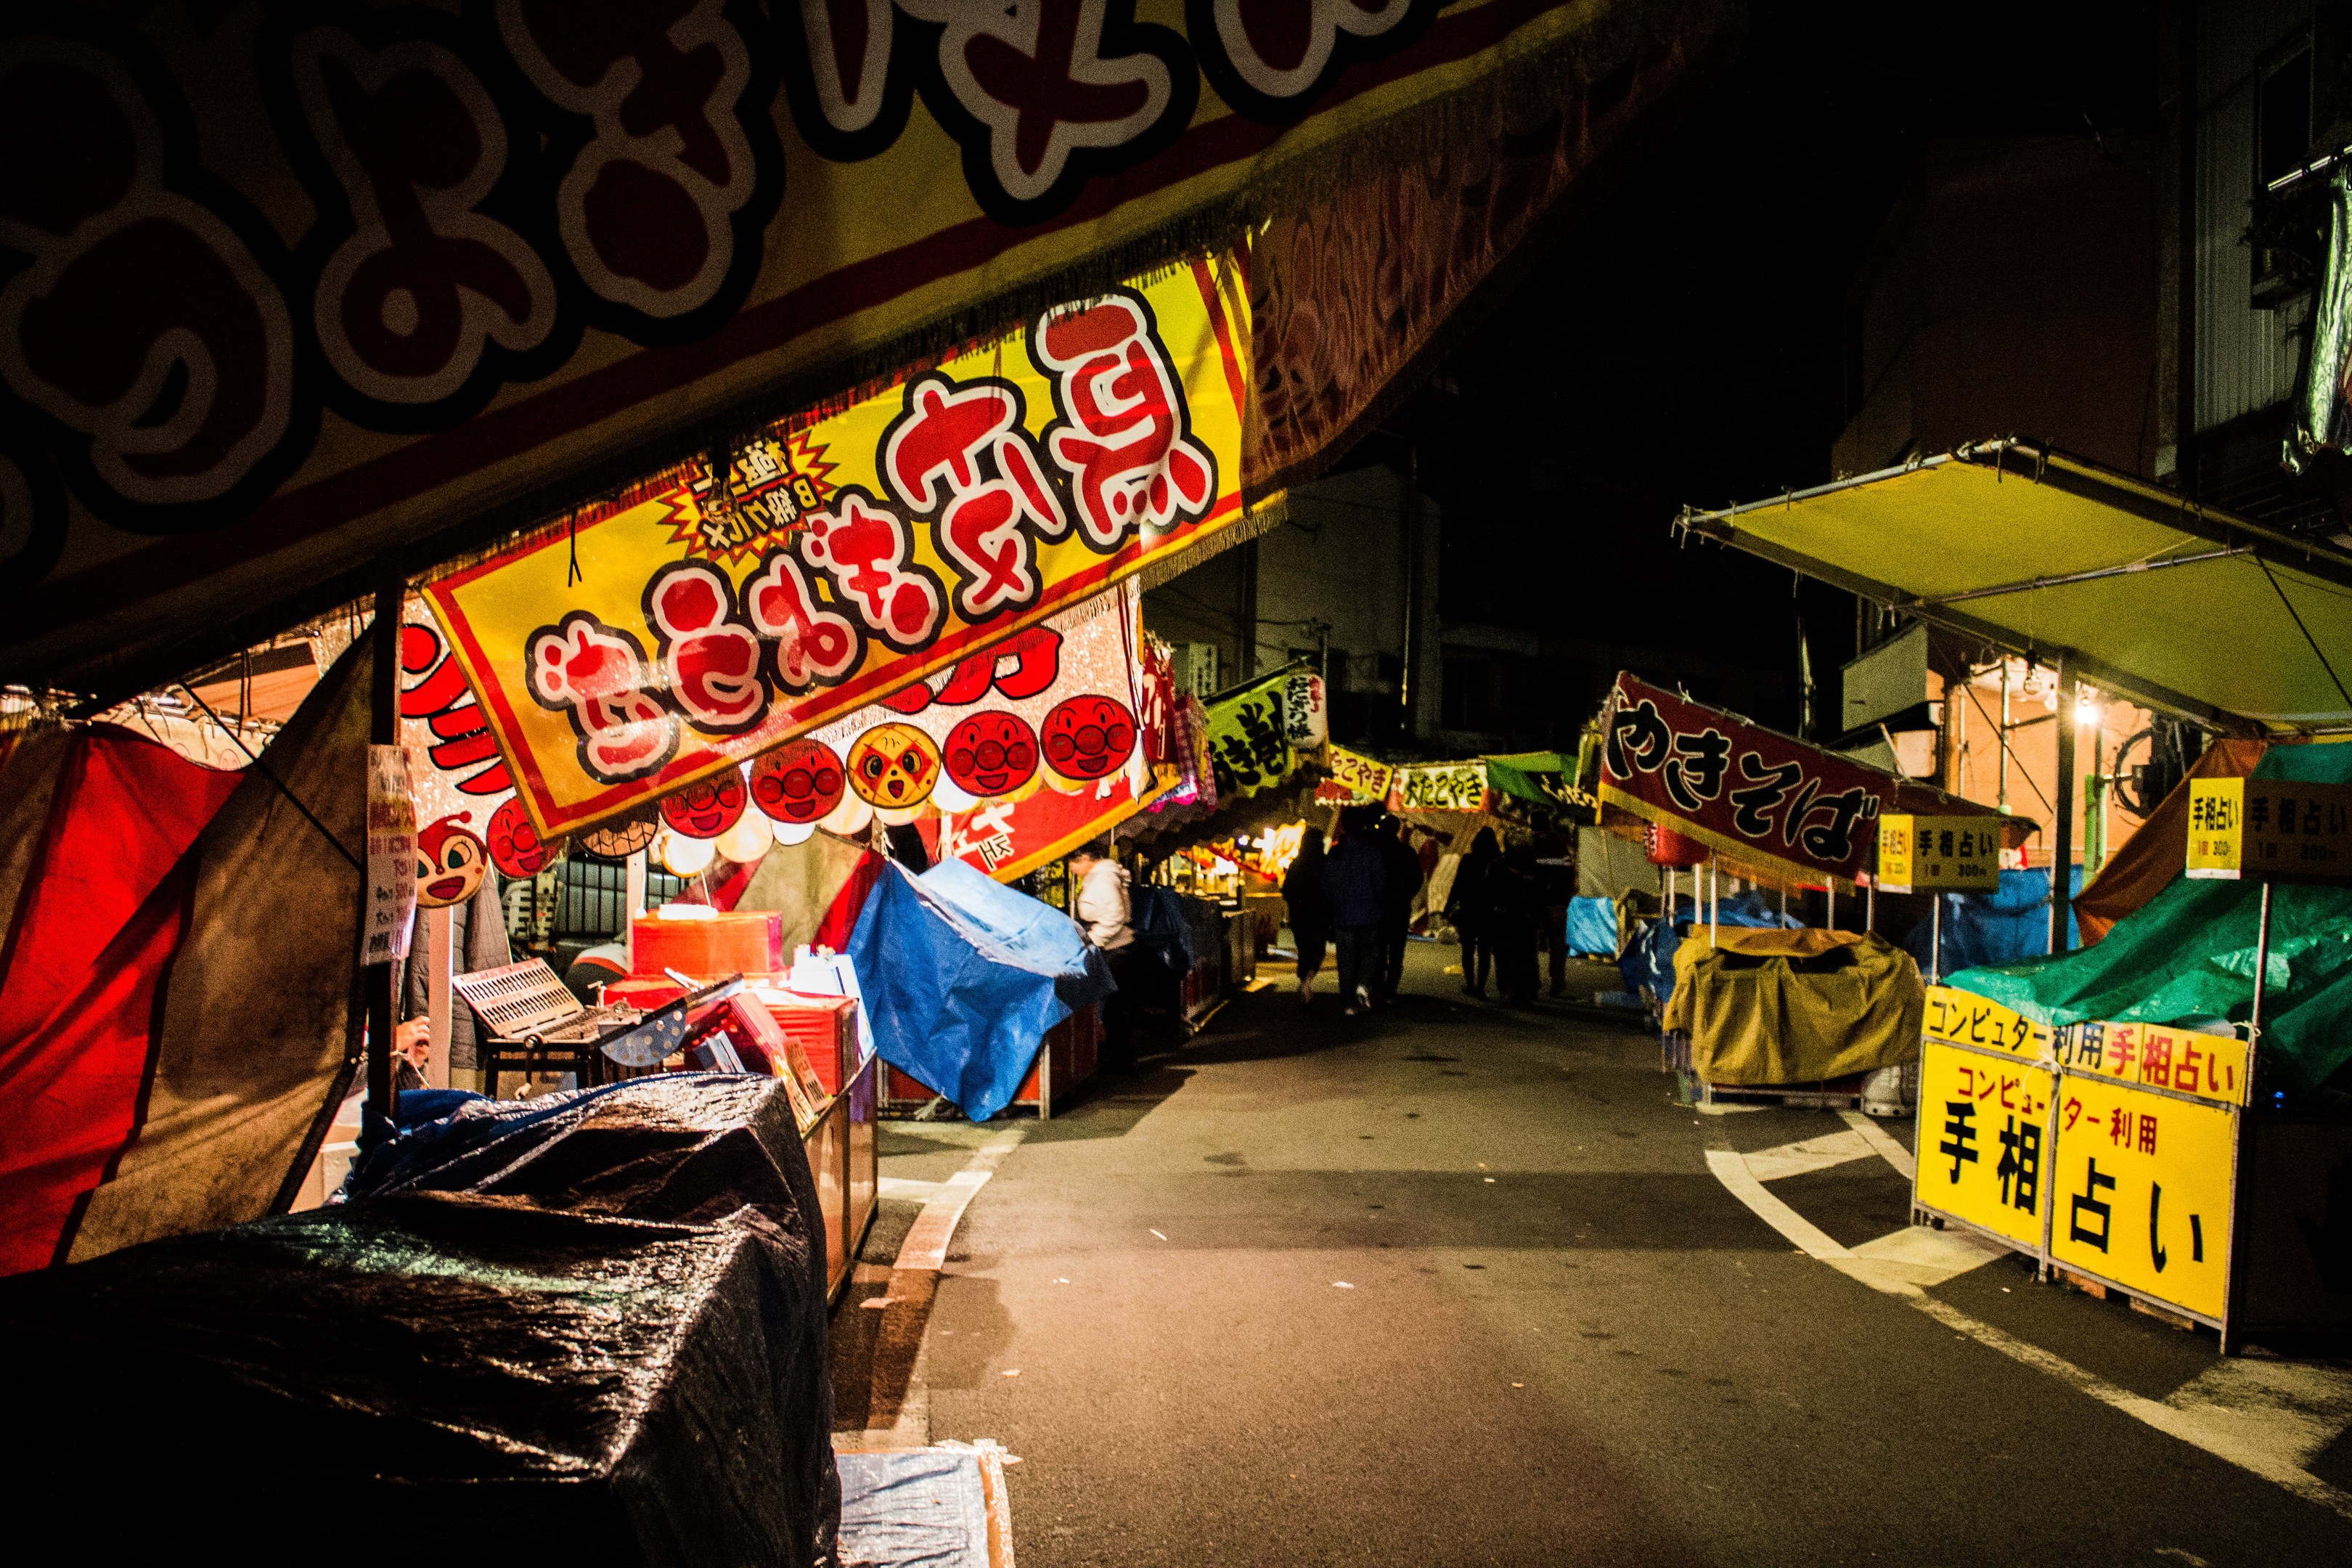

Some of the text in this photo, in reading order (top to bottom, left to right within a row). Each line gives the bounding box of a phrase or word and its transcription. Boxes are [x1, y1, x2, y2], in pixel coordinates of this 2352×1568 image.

[1606, 697, 1881, 862] やきそば
[2193, 796, 2239, 830] 手相占い
[1919, 829, 1993, 857] 手相占い
[2250, 796, 2347, 836] 手相占い
[1929, 999, 2235, 1093] コンピュター利用手相占い
[1939, 1101, 2204, 1274] 手相占い
